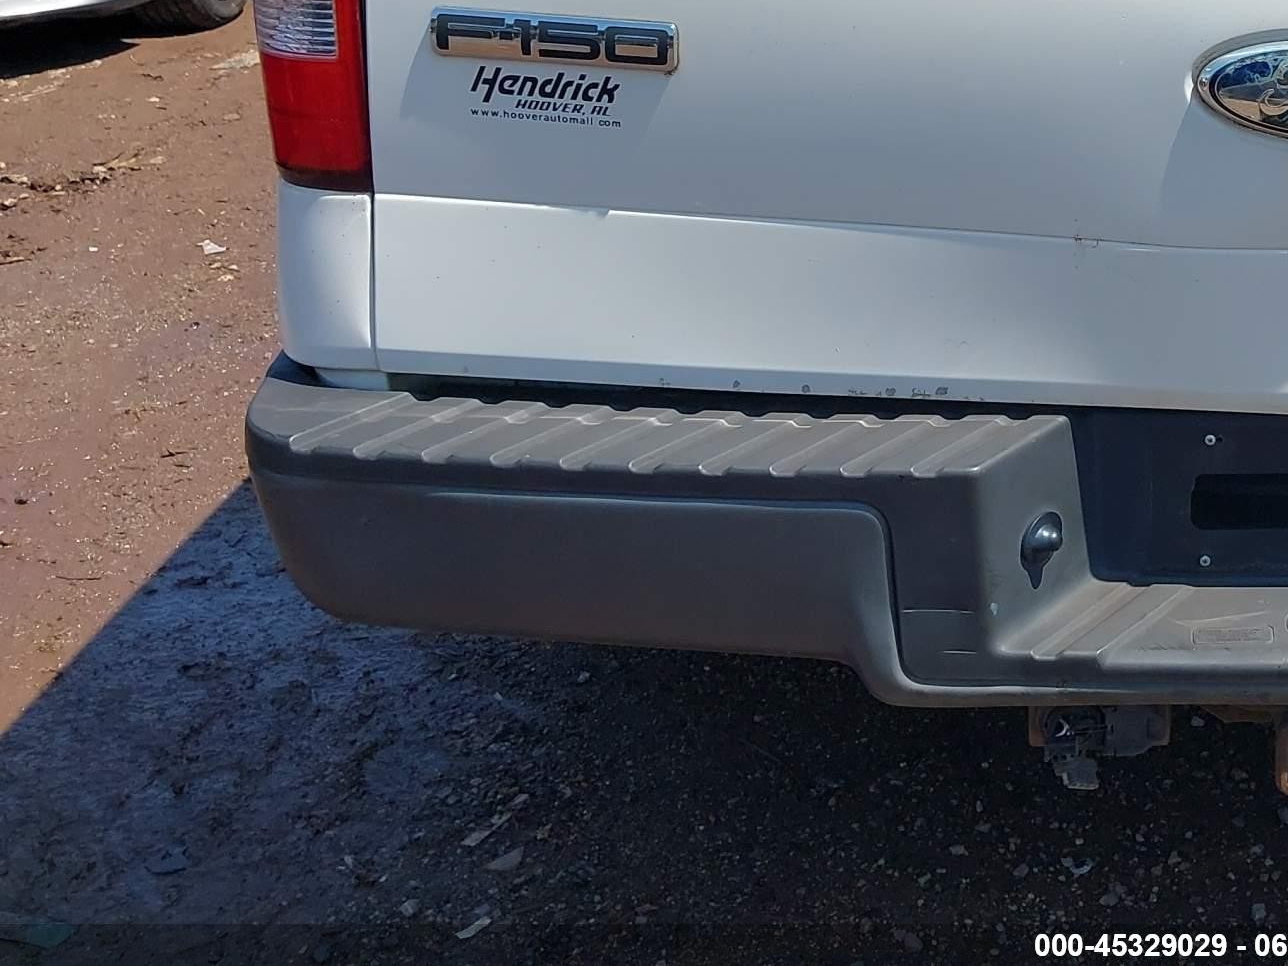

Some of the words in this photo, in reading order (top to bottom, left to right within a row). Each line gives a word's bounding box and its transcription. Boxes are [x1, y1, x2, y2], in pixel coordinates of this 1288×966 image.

[435, 13, 671, 66] F-150
[469, 65, 621, 104] Hendrick
[515, 98, 586, 116] HOOVER,
[590, 104, 612, 117] AL
